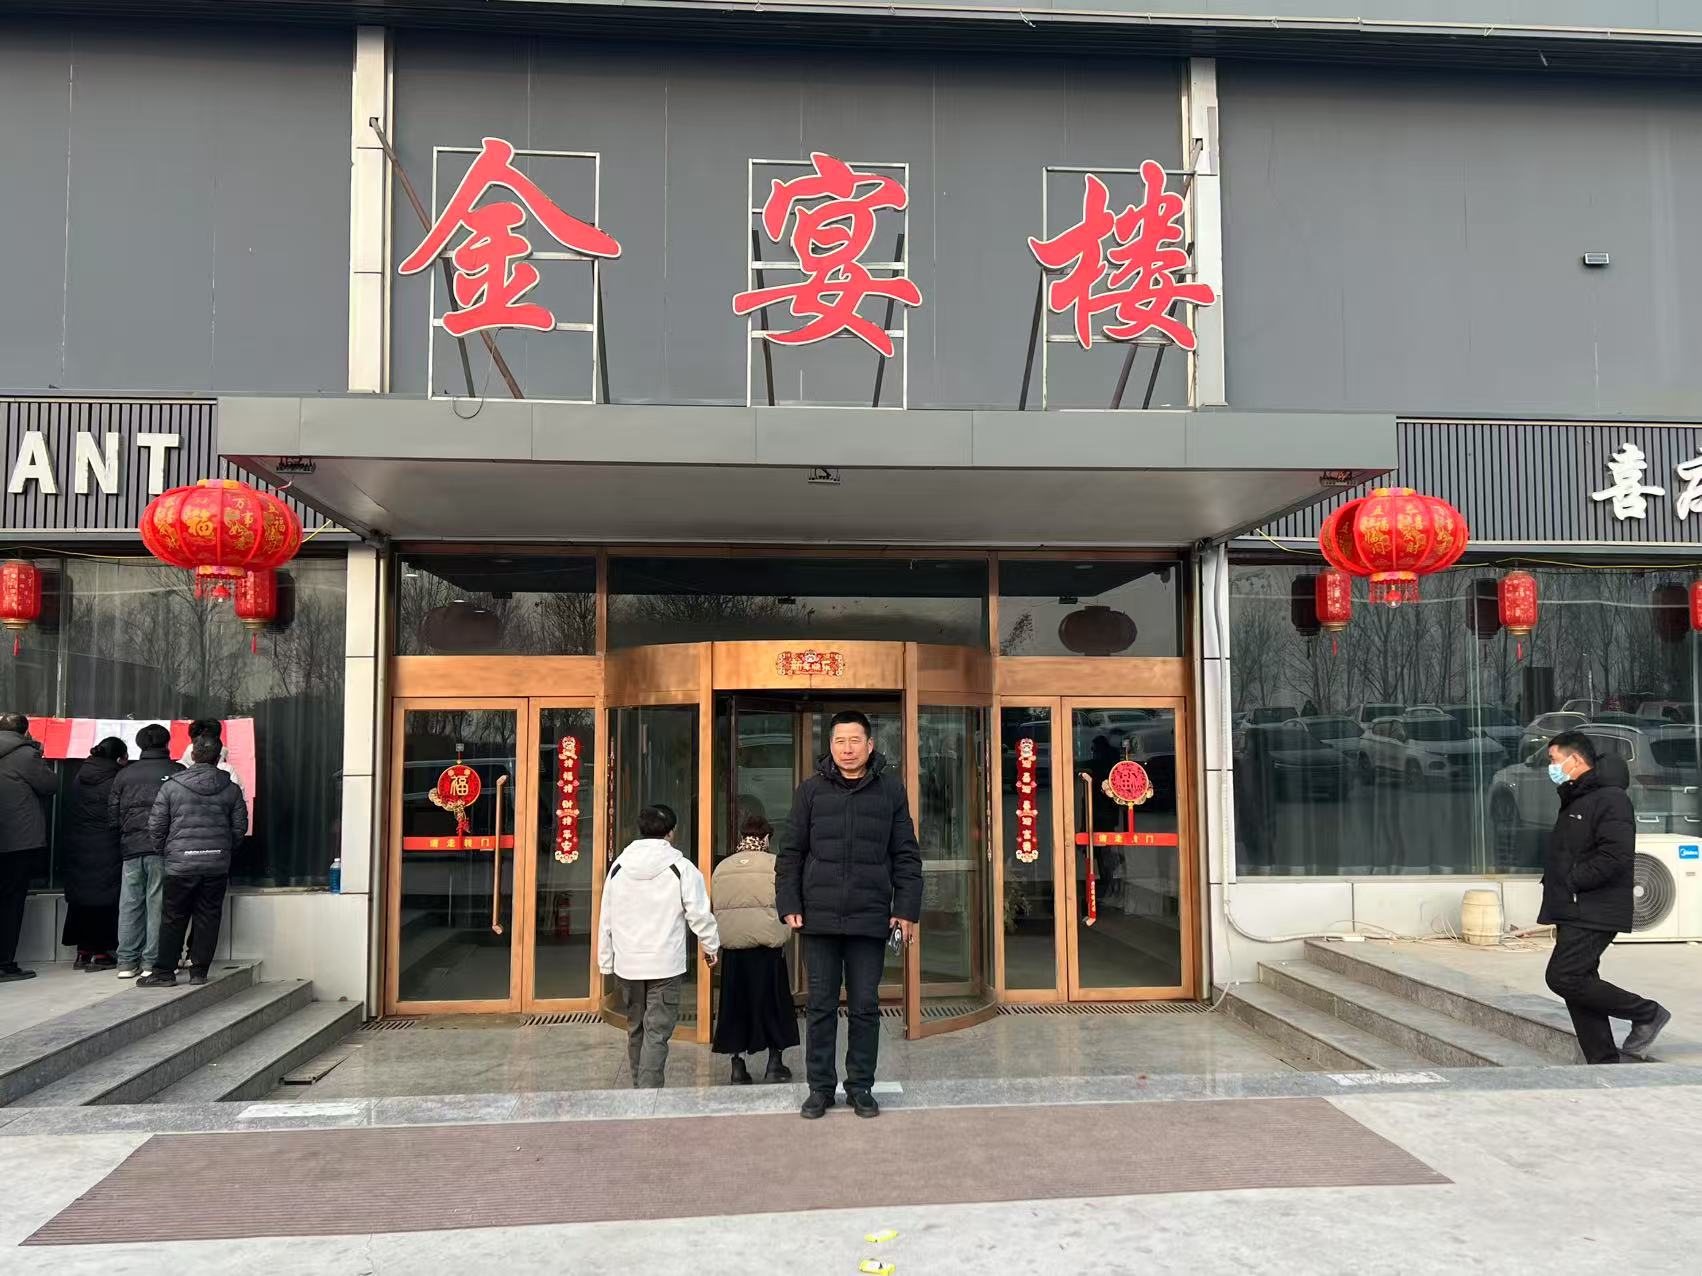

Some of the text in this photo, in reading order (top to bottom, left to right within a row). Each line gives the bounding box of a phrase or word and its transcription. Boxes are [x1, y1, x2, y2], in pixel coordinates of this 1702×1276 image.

[398, 137, 1214, 359] 金宴楼
[8, 431, 180, 495] ANT
[450, 775, 469, 796] 福
